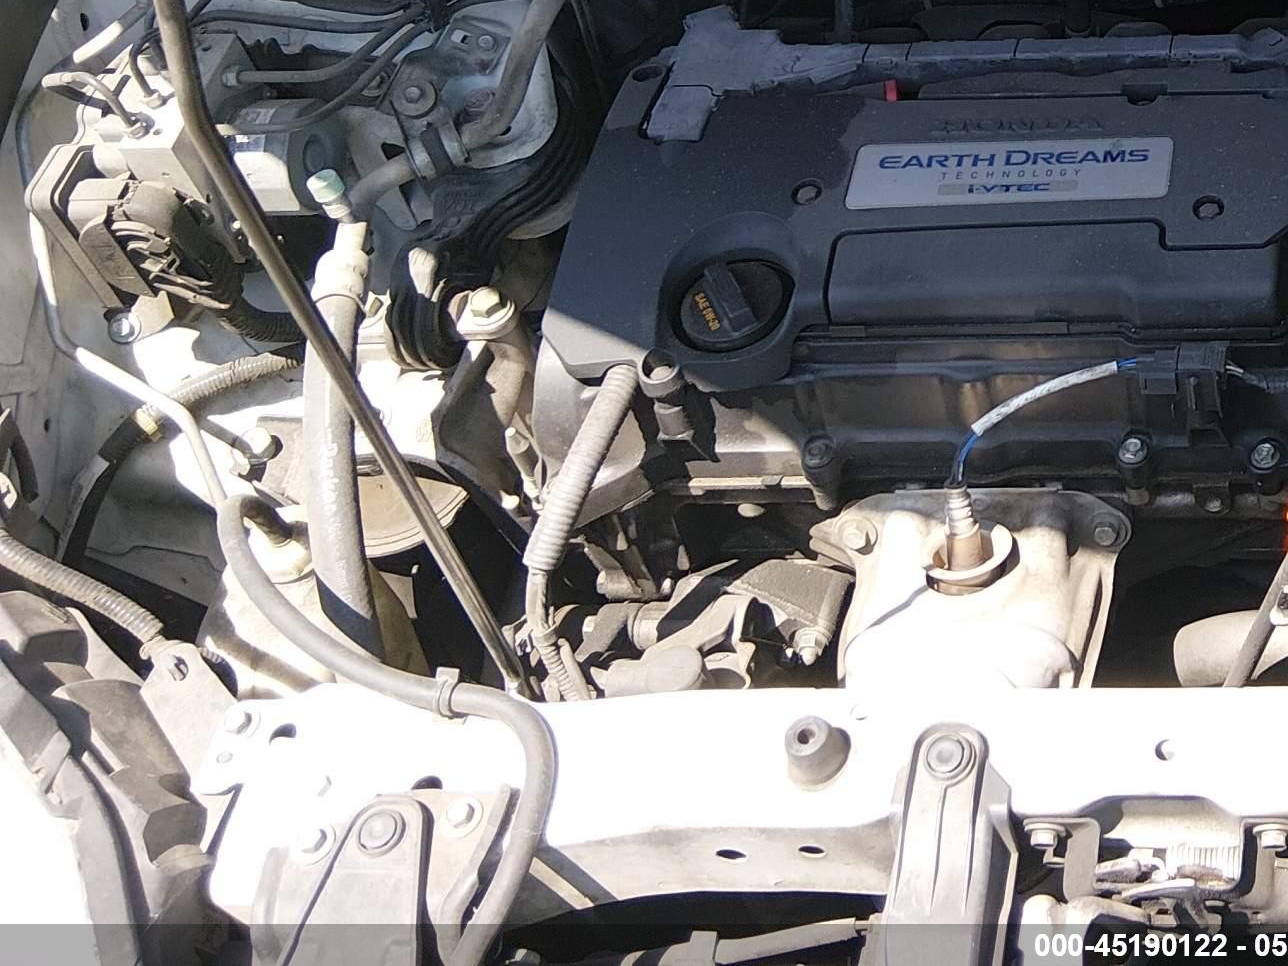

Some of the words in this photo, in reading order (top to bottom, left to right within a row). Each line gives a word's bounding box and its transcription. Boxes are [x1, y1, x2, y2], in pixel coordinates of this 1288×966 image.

[878, 153, 995, 170] EARTH
[1004, 148, 1150, 167] DREAMS
[940, 167, 1082, 181] TECHNOLOGY
[967, 183, 1051, 194] i-VTEC
[694, 292, 710, 310] SAE
